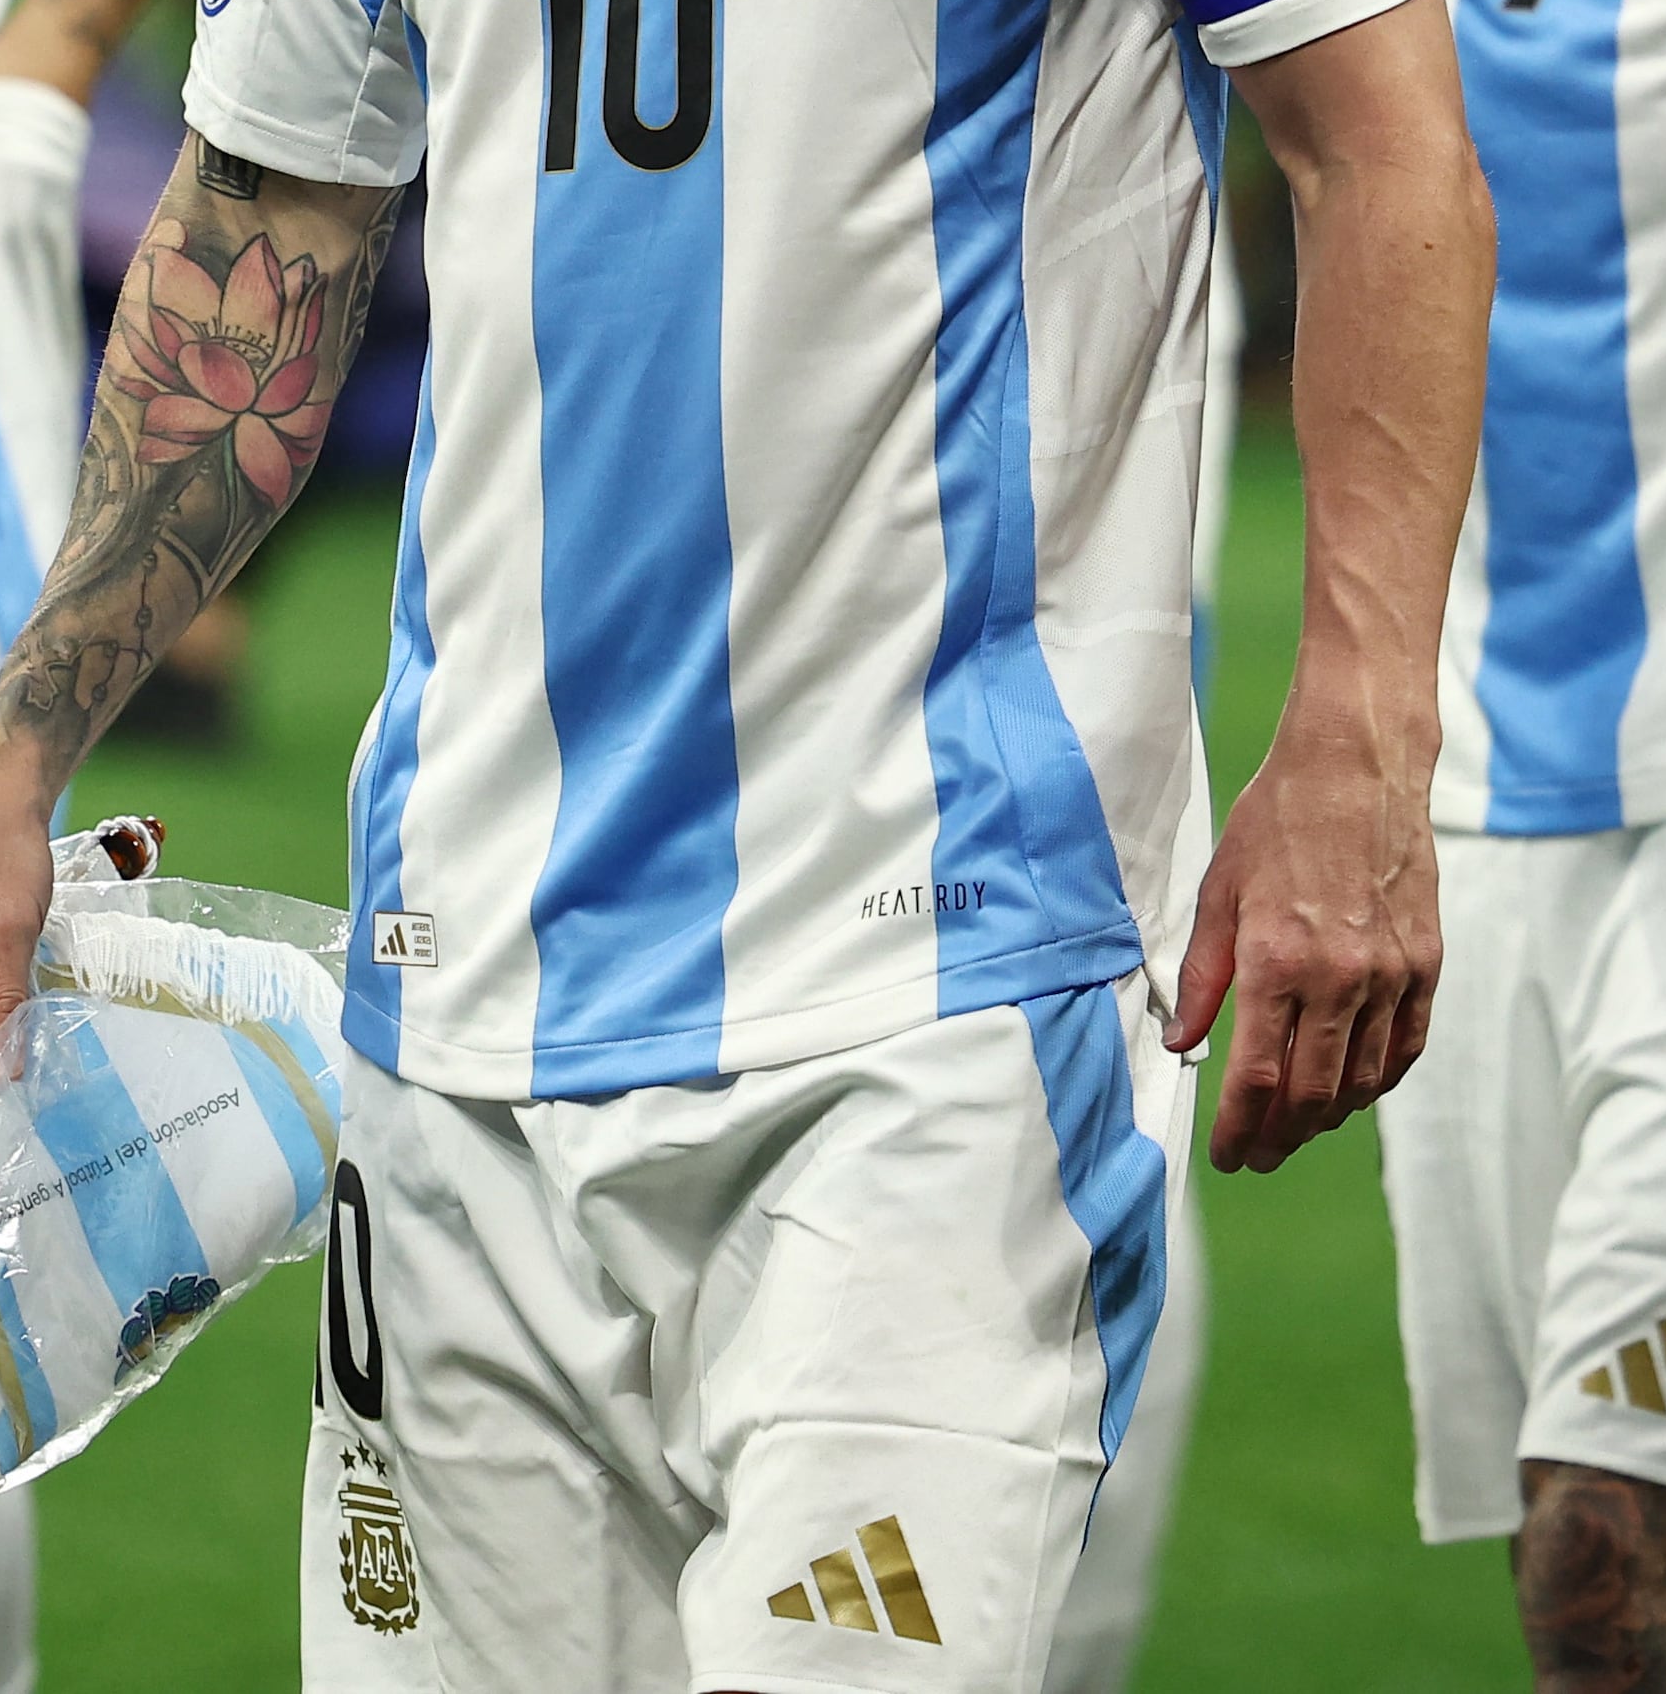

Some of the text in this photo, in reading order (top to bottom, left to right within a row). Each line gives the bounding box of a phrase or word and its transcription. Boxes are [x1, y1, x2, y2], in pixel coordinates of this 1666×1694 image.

[149, 1087, 240, 1145] Asociación
[63, 1155, 114, 1195] Fútbol
[115, 1137, 148, 1167] del
[316, 1156, 384, 1422] 0
[358, 1522, 405, 1593] AFA
